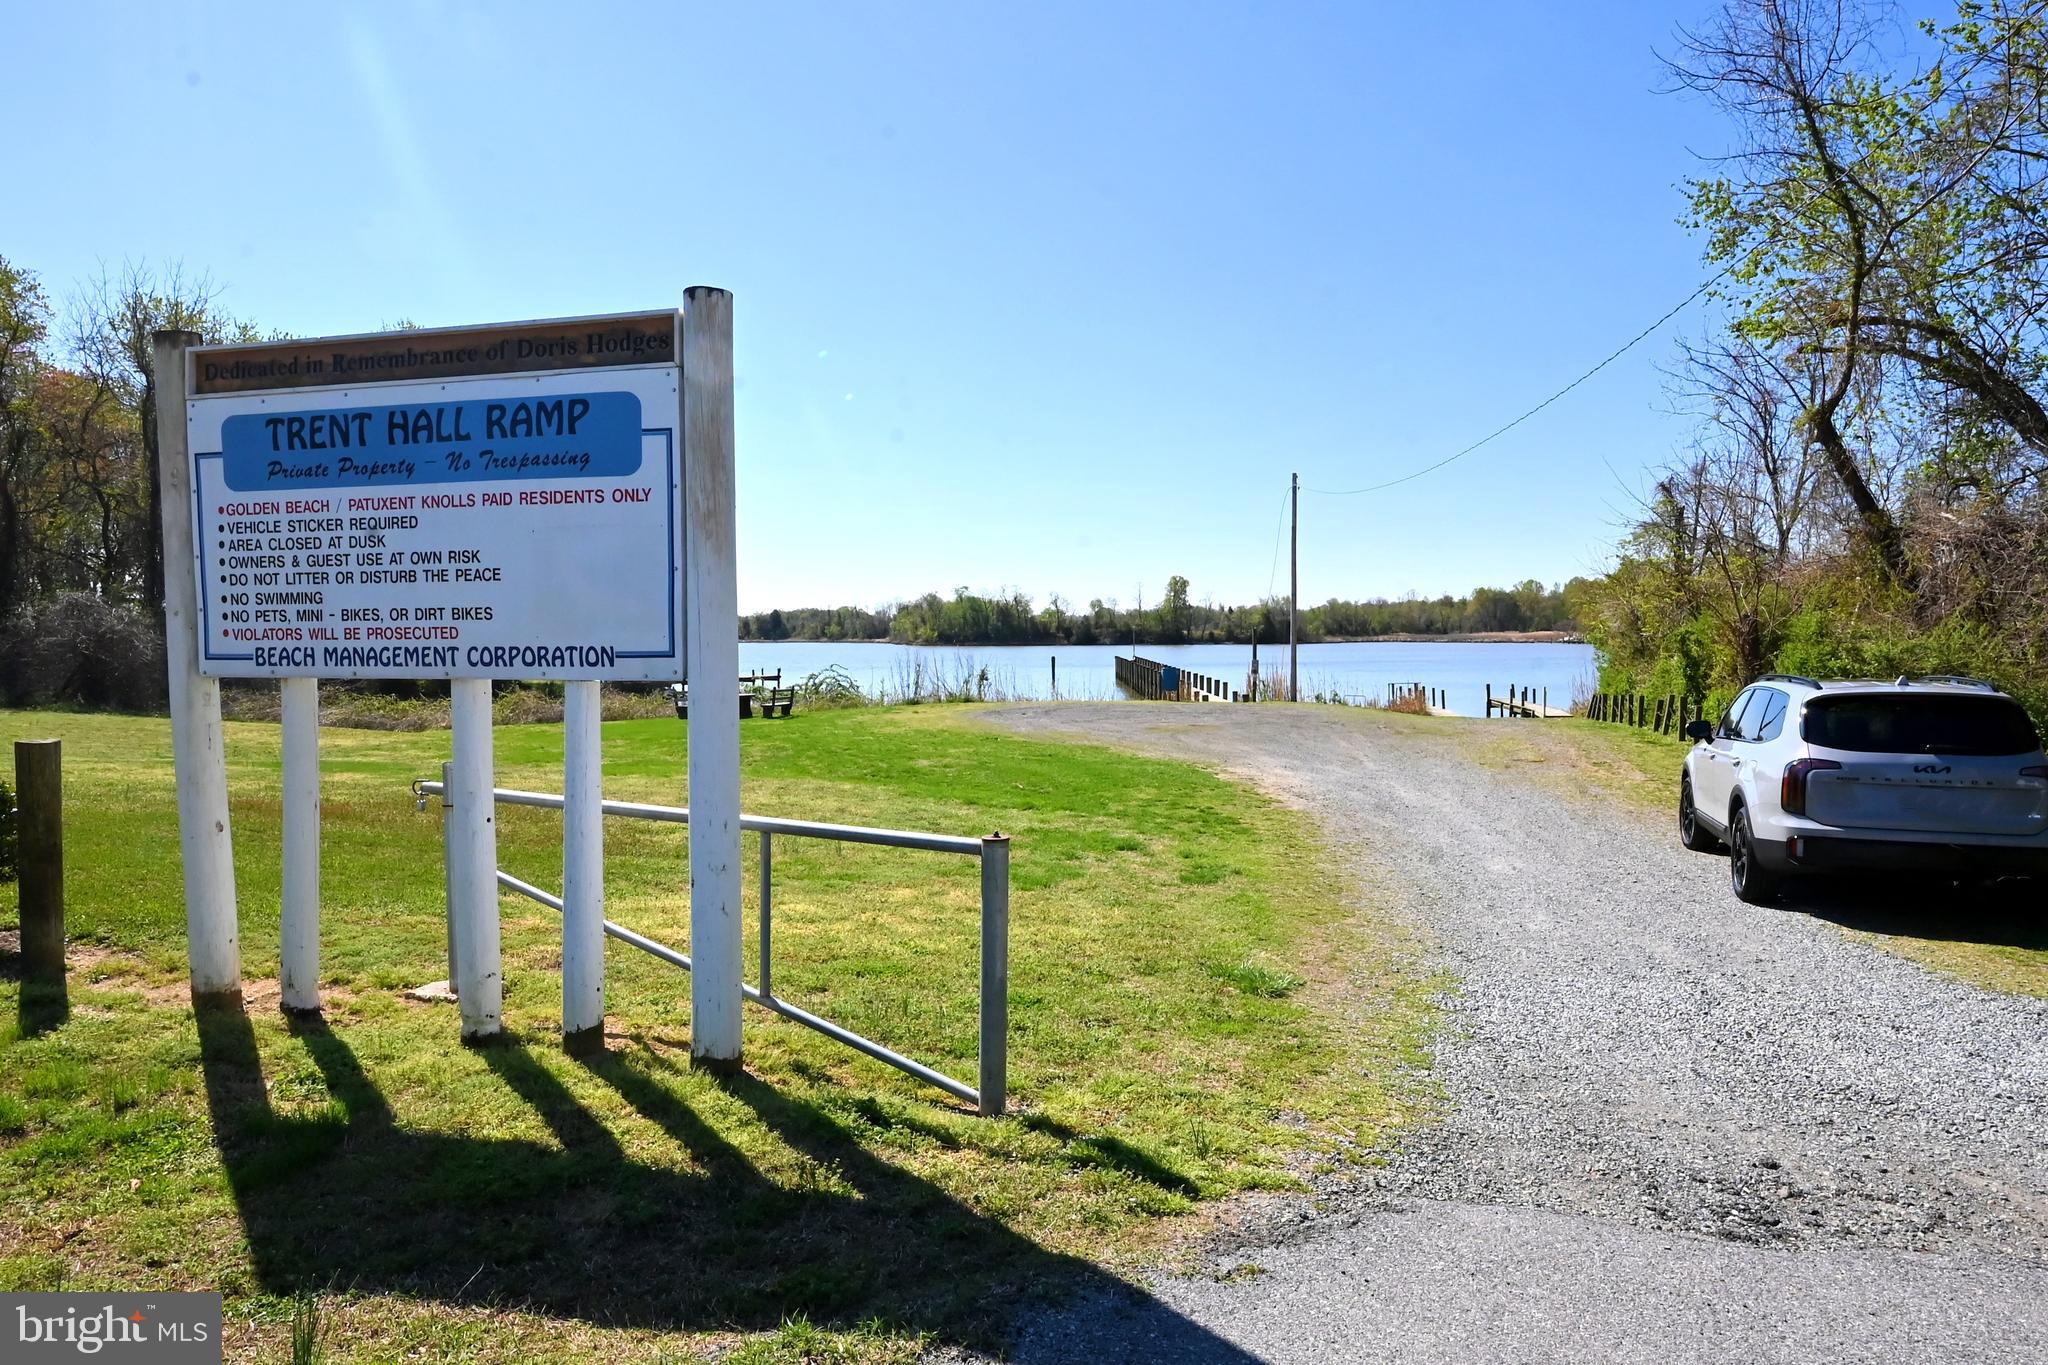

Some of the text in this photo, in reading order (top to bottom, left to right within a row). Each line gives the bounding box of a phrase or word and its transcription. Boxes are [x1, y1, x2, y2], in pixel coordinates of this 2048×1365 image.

[204, 330, 670, 382] Dedicated in Remembrance of Doris Hodges
[265, 398, 590, 451] TRENT HALL RAMP
[267, 460, 329, 481] Private
[337, 456, 416, 480] Property
[445, 451, 471, 472] No
[479, 449, 591, 472] Trespassing
[226, 502, 280, 516] GOLDEN
[285, 499, 330, 514] BEACH
[348, 496, 416, 511] PATUXENT
[421, 493, 476, 509] KNOLLS
[482, 492, 513, 506] PAID
[519, 489, 605, 505] RESIDENTS
[612, 487, 651, 503] ONLY
[227, 516, 418, 534] VEHICLE STICKER REQUIRED
[228, 535, 386, 551] AREA CLOSED AT DUSK
[228, 550, 481, 569] OWNERS & GUEST USE AT OWN RISK
[229, 567, 501, 586] DO NOT LITTER OR DISTURB THE PEACE
[231, 592, 323, 605] NO SWIMMING
[231, 610, 249, 623] NO
[255, 609, 291, 624] PETS,
[296, 609, 323, 622] MINI
[341, 608, 384, 624] BIKES,
[389, 608, 409, 621] OR
[415, 607, 445, 621] DIRT
[452, 607, 493, 621] BIKES
[232, 626, 459, 641] VIOLATORS WILL BE PROSECUTED
[255, 646, 615, 667] BEACH MANAGEMENT CORPORATION
